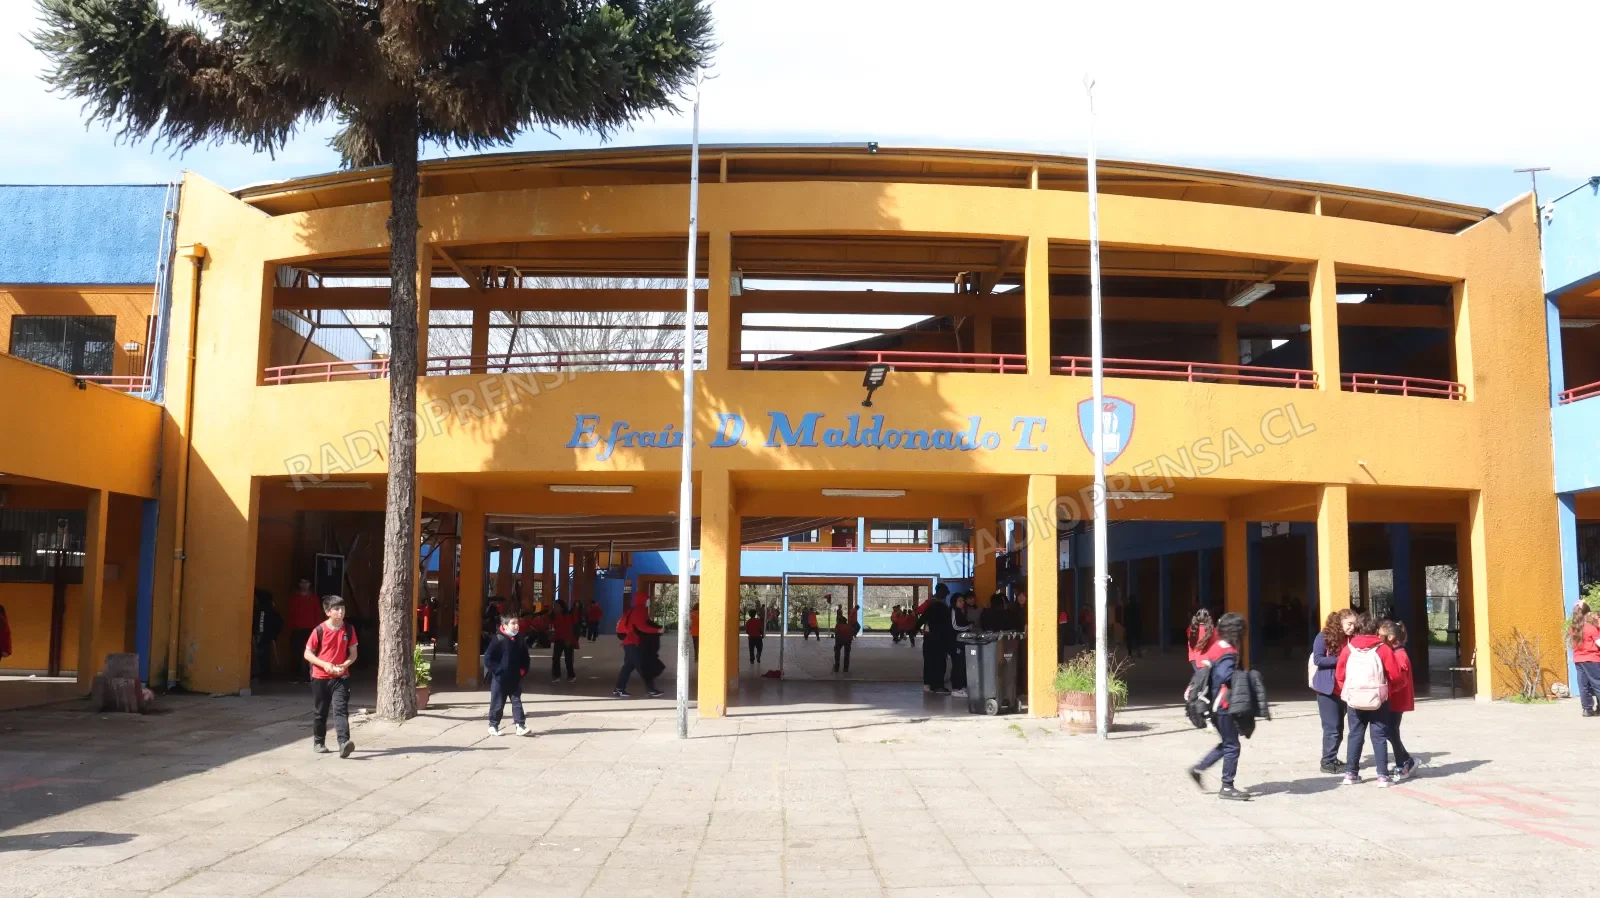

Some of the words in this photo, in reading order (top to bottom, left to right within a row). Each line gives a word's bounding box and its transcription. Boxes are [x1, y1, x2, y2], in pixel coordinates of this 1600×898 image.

[708, 412, 748, 449] D.
[763, 411, 1001, 451] Maldonado
[1011, 415, 1049, 452] T.
